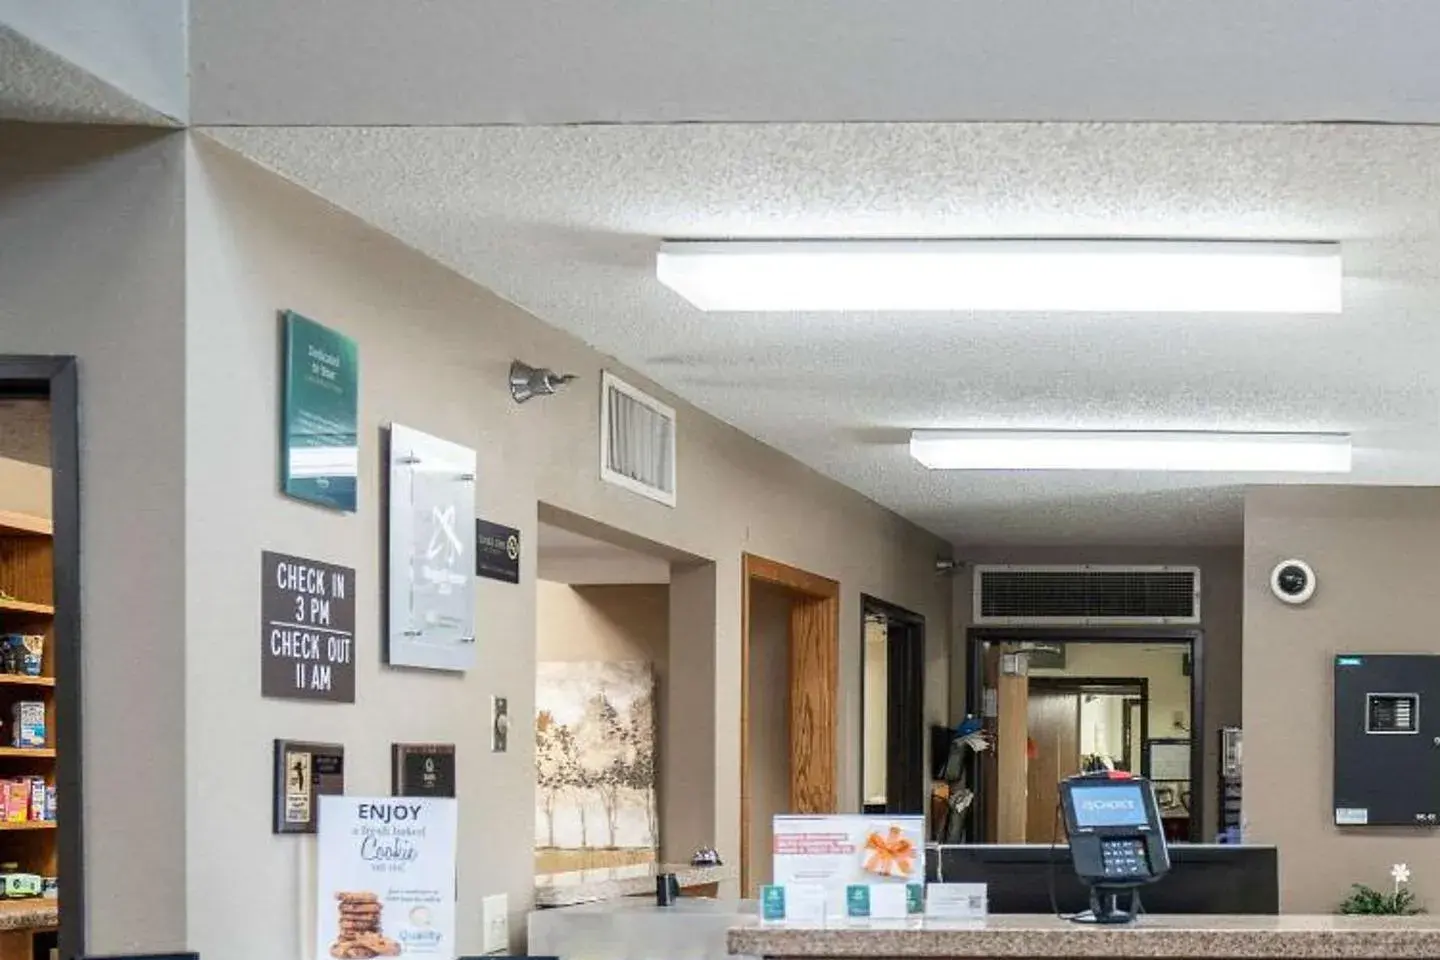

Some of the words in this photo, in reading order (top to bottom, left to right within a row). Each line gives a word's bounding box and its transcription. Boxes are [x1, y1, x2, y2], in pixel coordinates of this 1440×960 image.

[277, 562, 325, 595] CHECK
[332, 573, 345, 599] IN
[295, 596, 305, 621] 3
[310, 598, 330, 626] PM
[270, 629, 320, 660] CHECK
[327, 636, 351, 663] OUT
[296, 663, 306, 689] 11
[311, 664, 331, 691] AM
[358, 803, 422, 824] ENJOY
[392, 825, 426, 838] baked
[360, 834, 418, 861] Cookie
